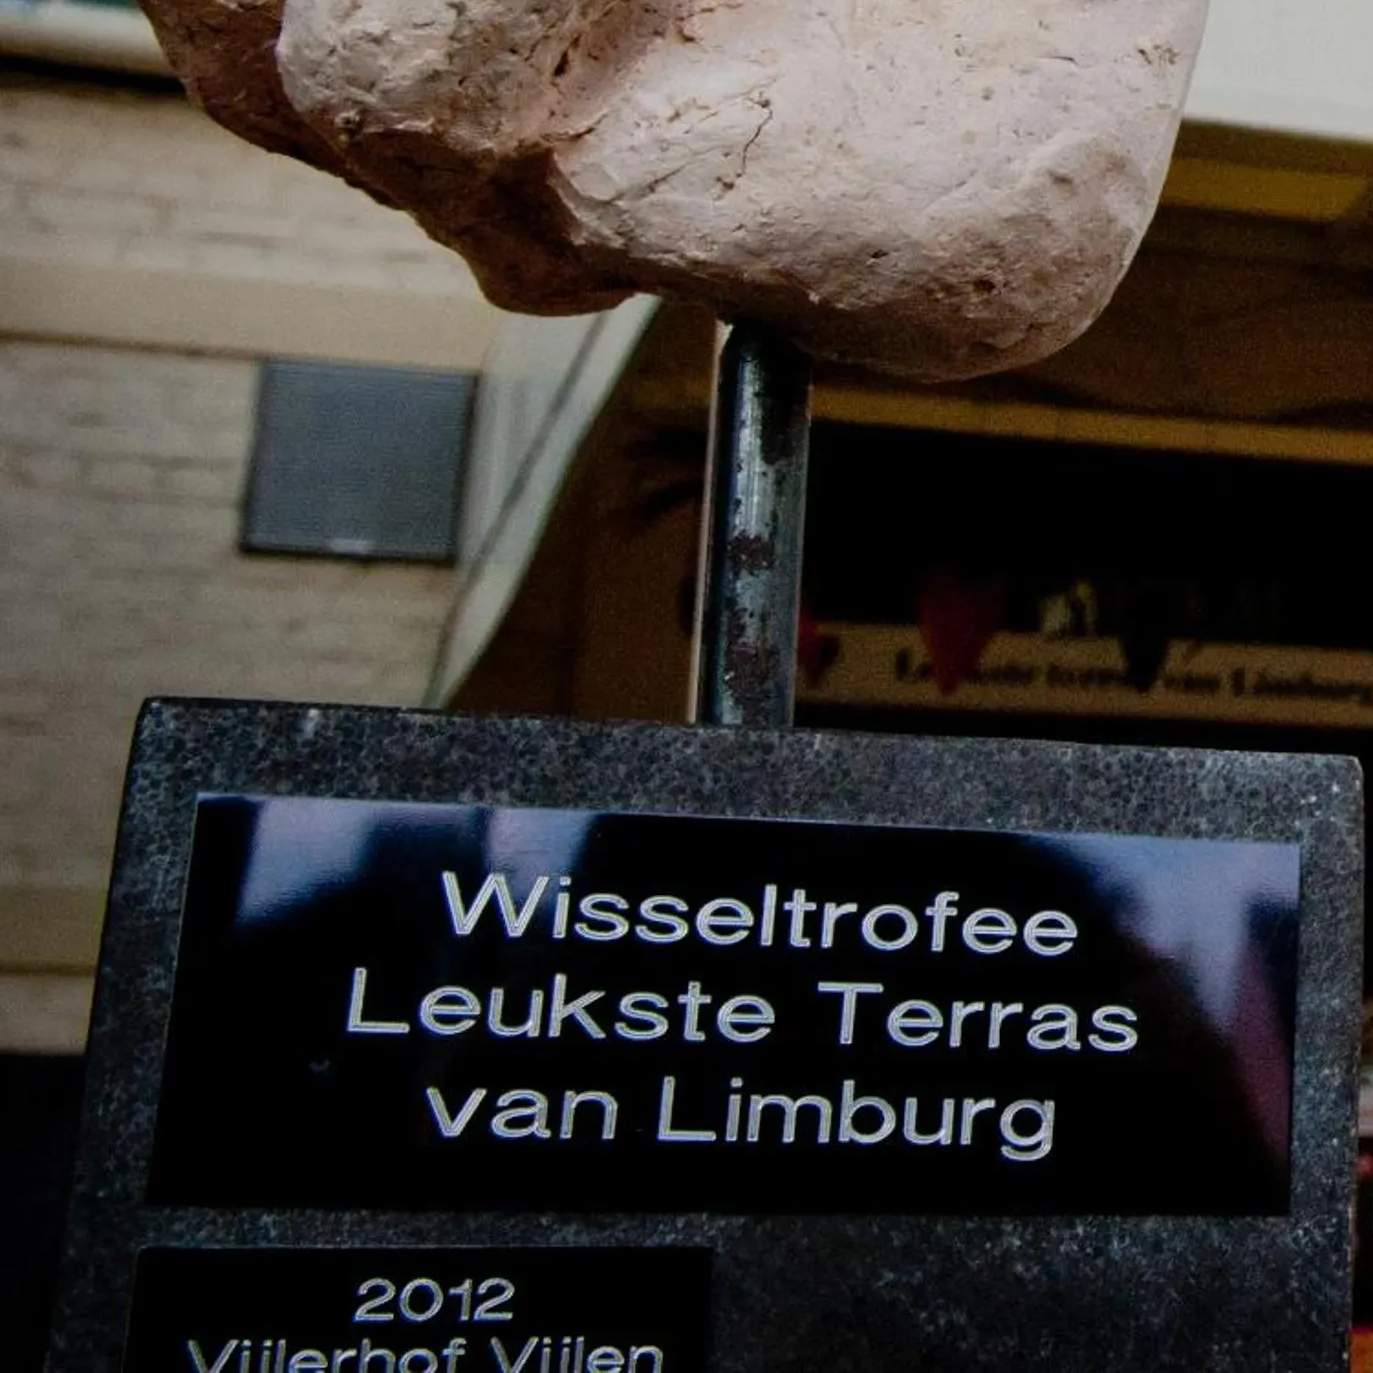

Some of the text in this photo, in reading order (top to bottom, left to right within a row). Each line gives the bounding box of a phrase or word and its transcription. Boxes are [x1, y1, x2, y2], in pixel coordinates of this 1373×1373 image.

[442, 871, 1078, 956] Wisseltrofee
[347, 967, 1139, 1053] Leukste Terras
[426, 1075, 1056, 1162] van Limburg
[354, 1277, 515, 1322] 2012
